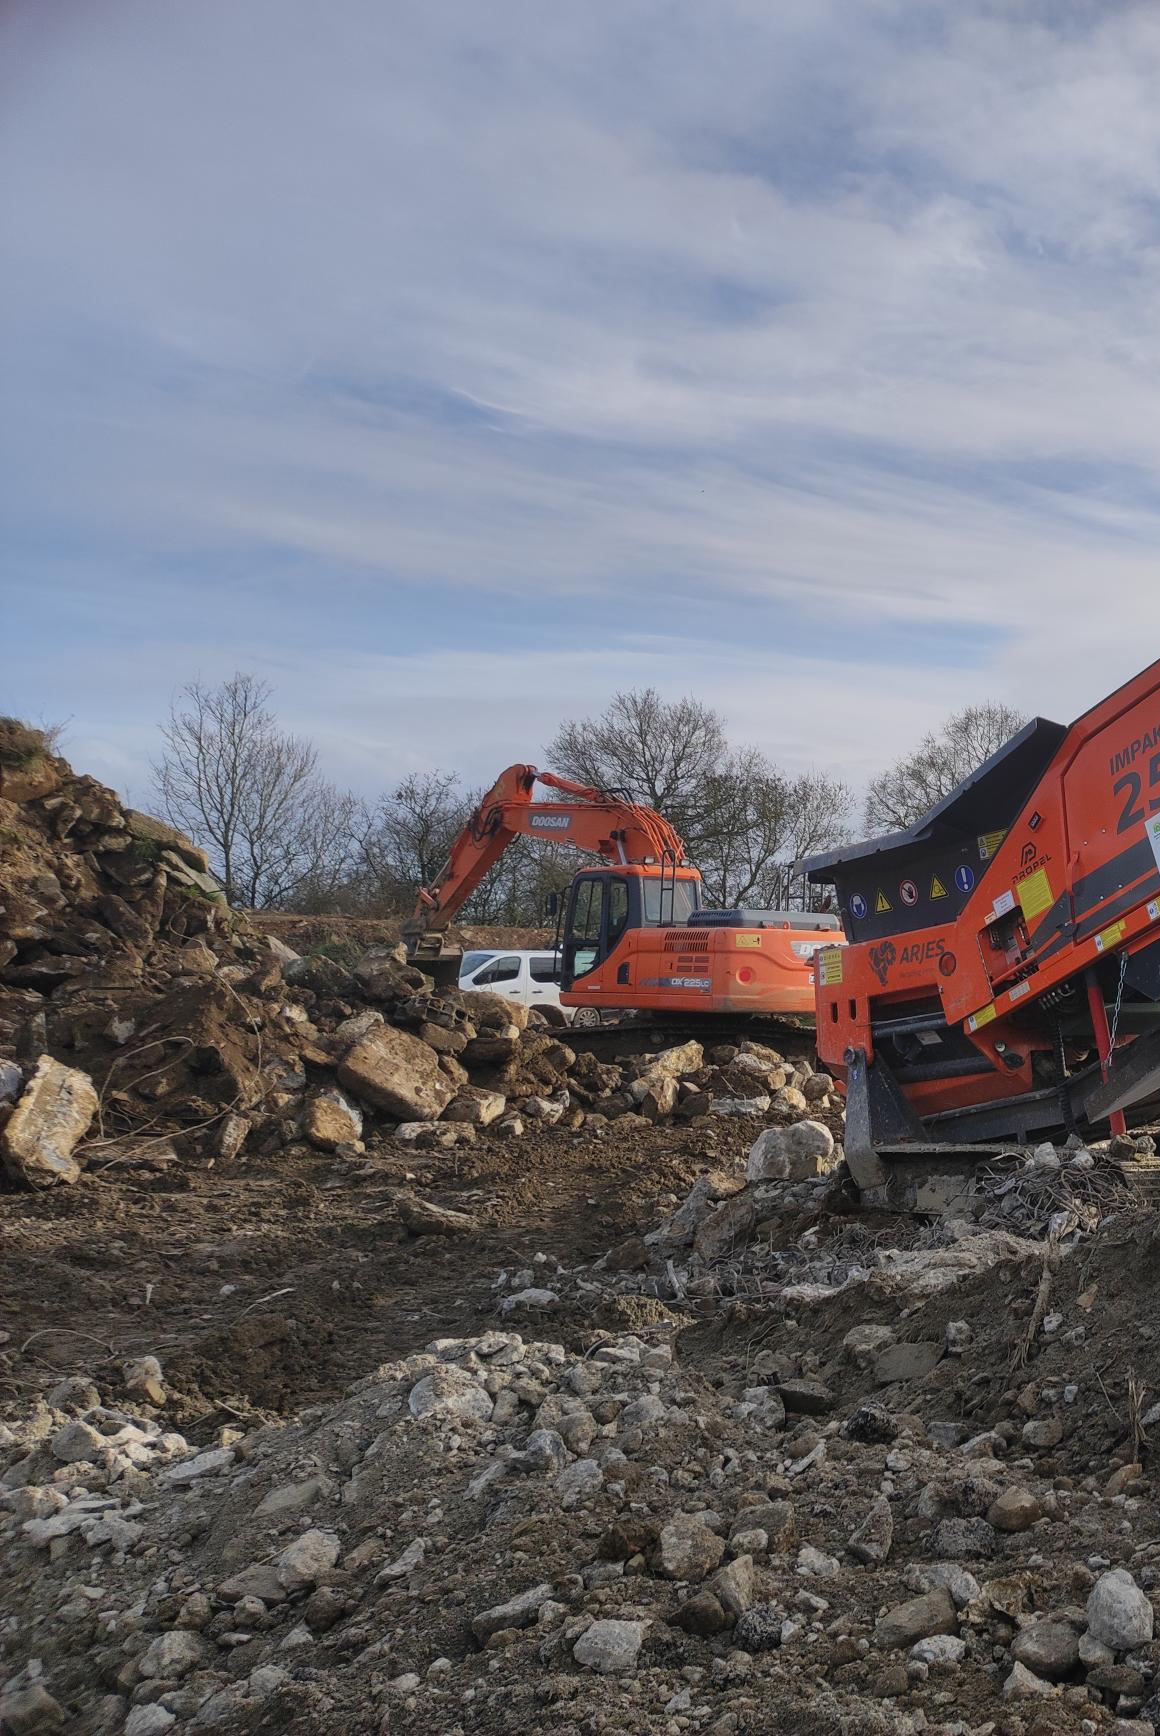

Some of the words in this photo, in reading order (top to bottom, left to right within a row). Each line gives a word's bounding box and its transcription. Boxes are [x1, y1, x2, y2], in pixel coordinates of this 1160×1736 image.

[532, 816, 570, 828] DOOSAN
[1011, 854, 1052, 884] PROPEL
[901, 938, 946, 965] ARJES
